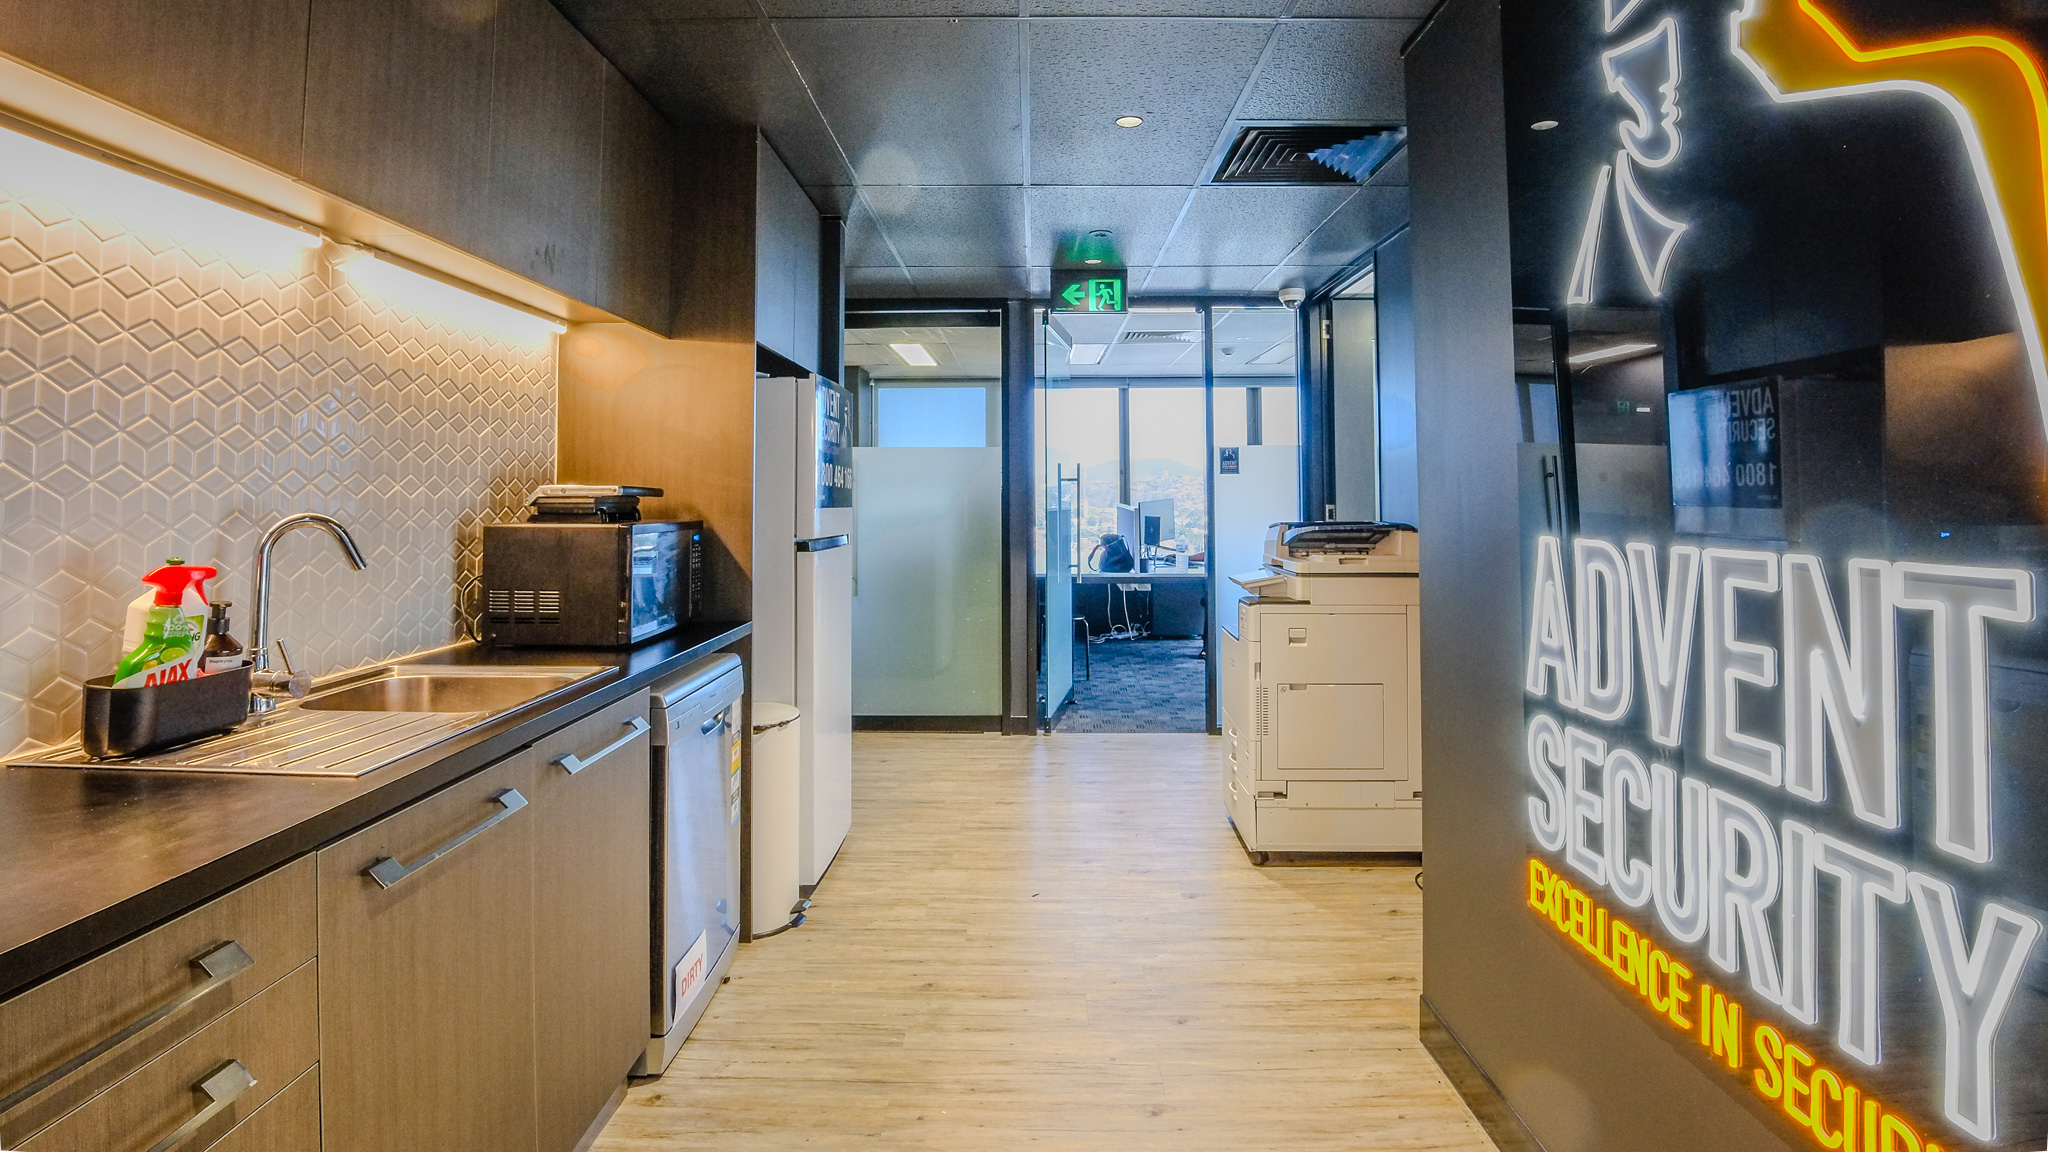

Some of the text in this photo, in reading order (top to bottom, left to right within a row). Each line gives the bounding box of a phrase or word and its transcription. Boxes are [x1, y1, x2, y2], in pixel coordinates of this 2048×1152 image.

[144, 659, 192, 687] AJAX
[1526, 535, 2036, 863] ADVENT
[682, 953, 703, 997] DIRTY
[1527, 714, 2043, 1141] SECURITY
[1530, 859, 1693, 1030] EXCELLENCE
[1702, 984, 1743, 1069] IN
